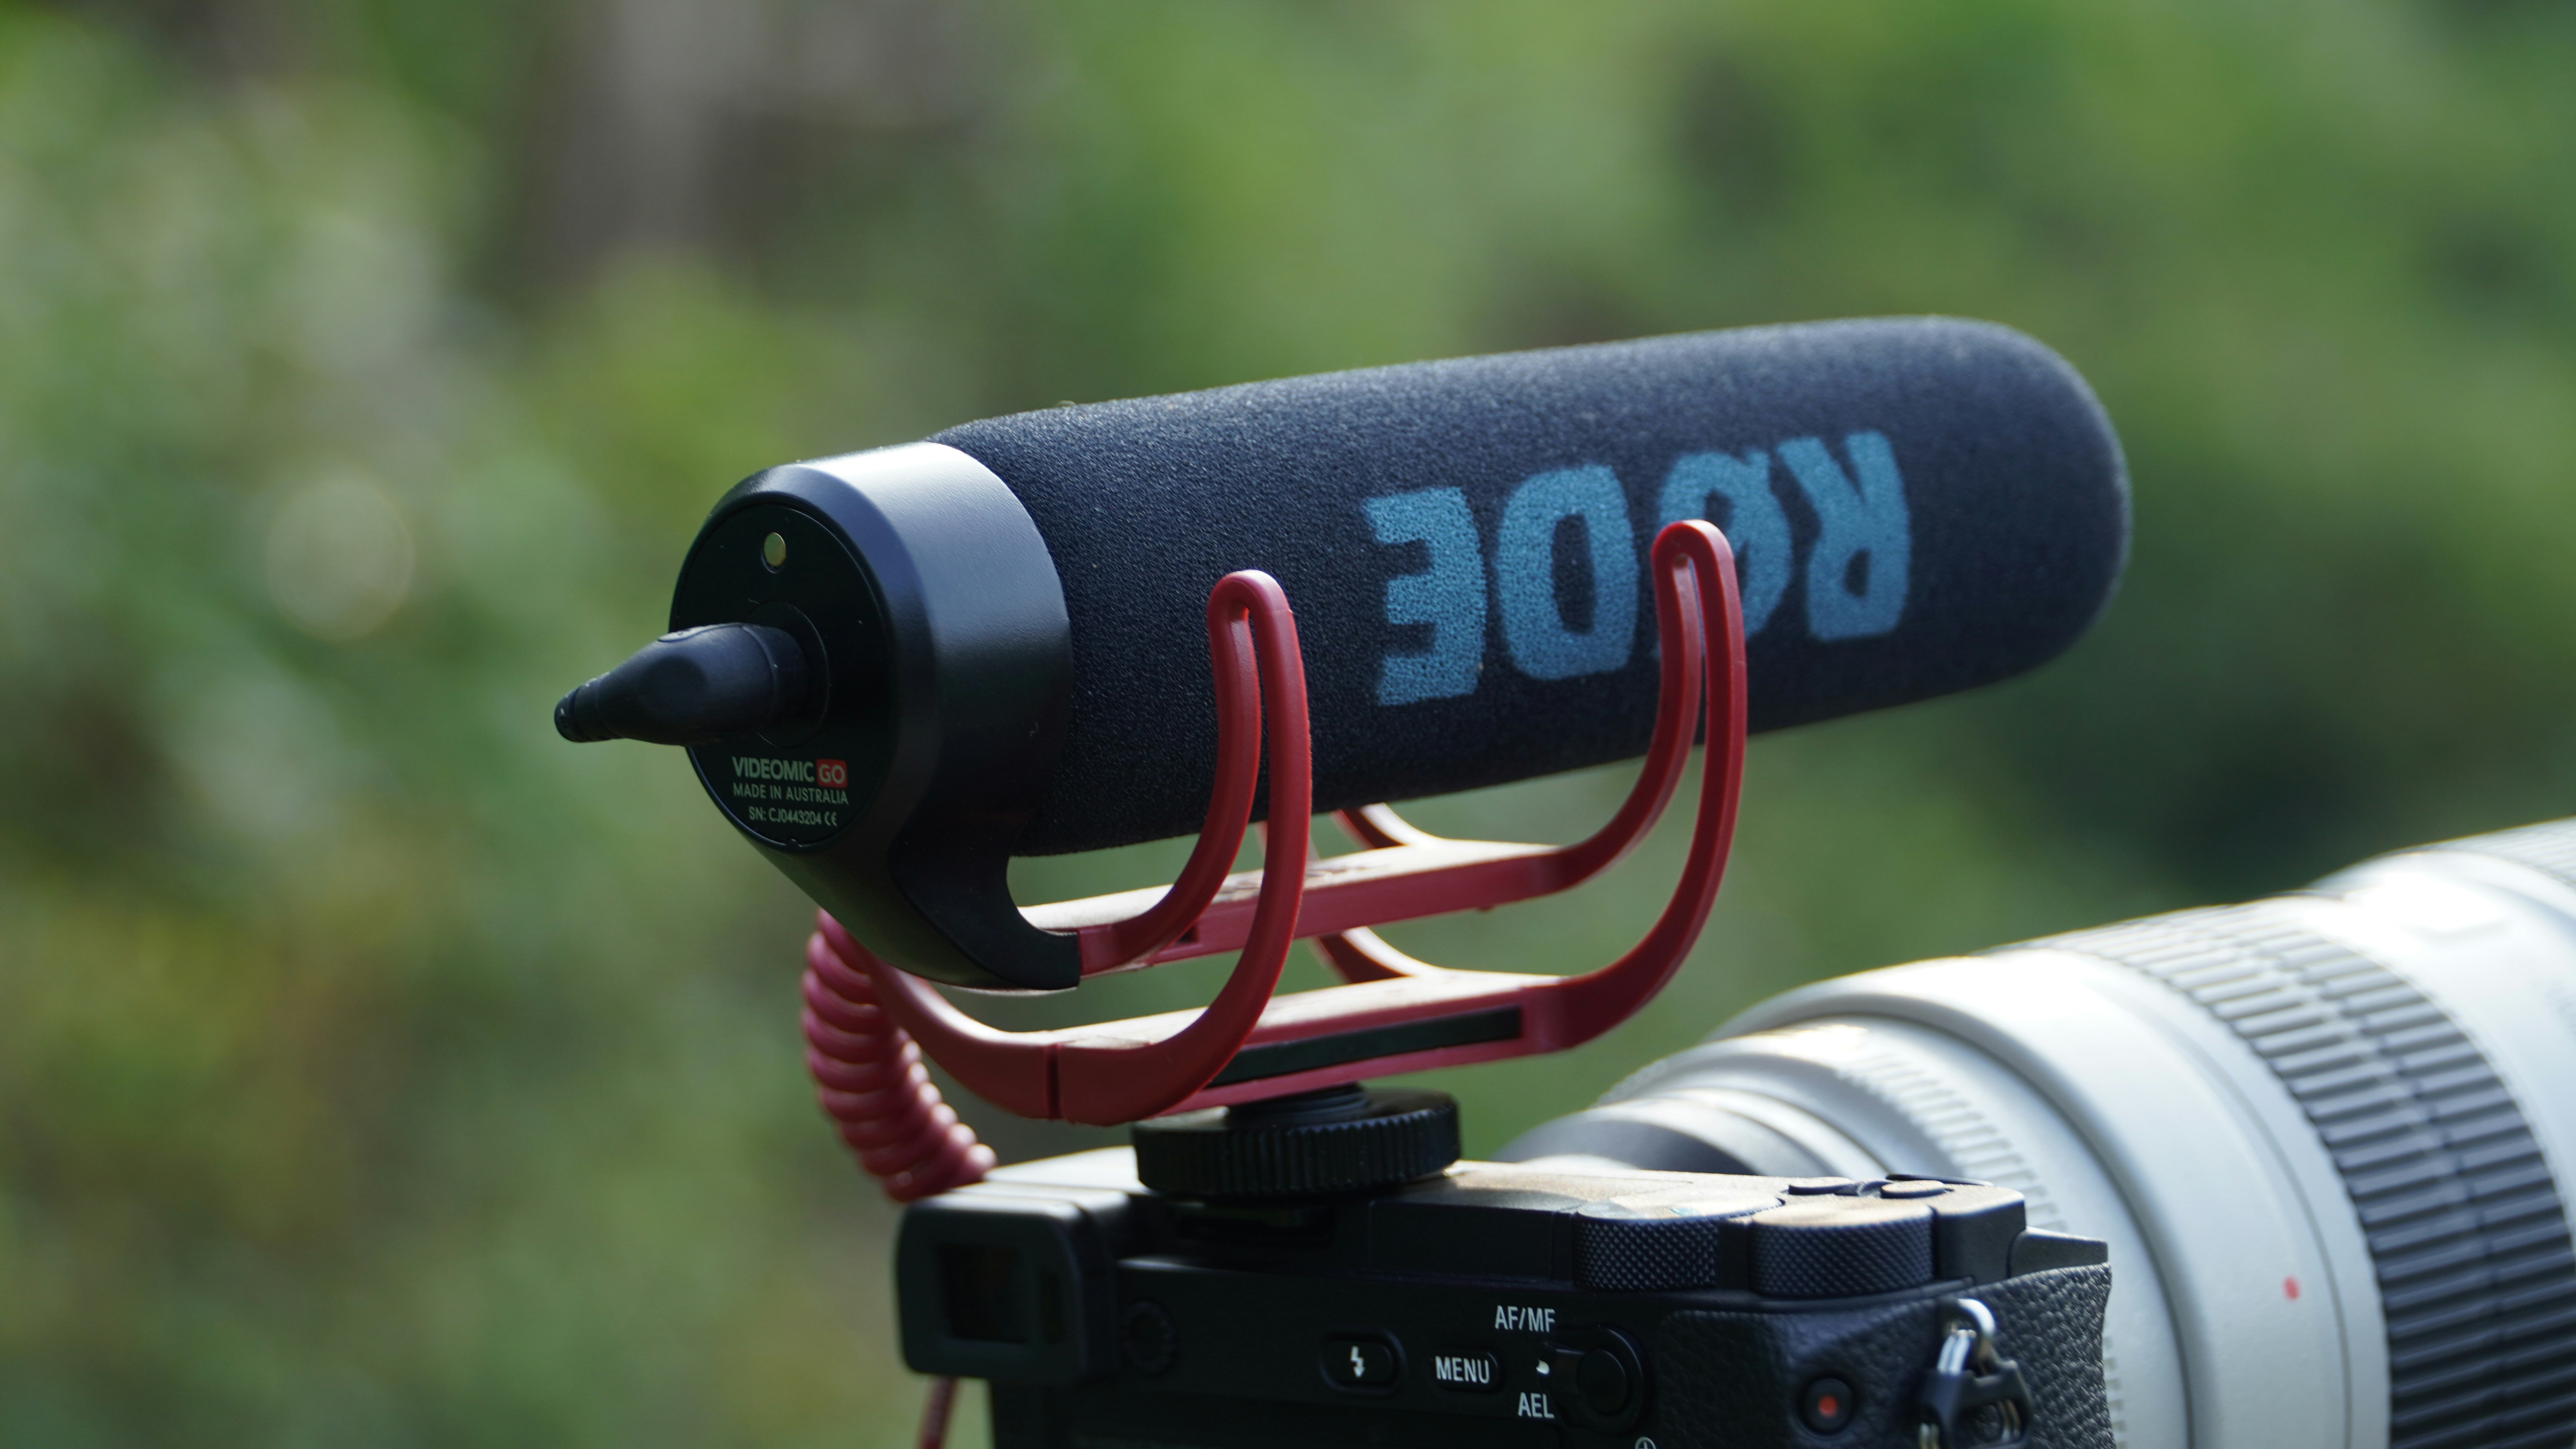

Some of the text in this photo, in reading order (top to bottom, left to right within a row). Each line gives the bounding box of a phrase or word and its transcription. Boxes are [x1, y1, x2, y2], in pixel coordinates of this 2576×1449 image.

[732, 756, 846, 784] VIDEOMIC GO
[732, 782, 849, 805] MADE IN AUSTRALIA
[748, 806, 767, 821] SN:
[1495, 1305, 1555, 1332] AF/MF
[1435, 1356, 1490, 1384] MENU
[1517, 1392, 1555, 1419] AEL
